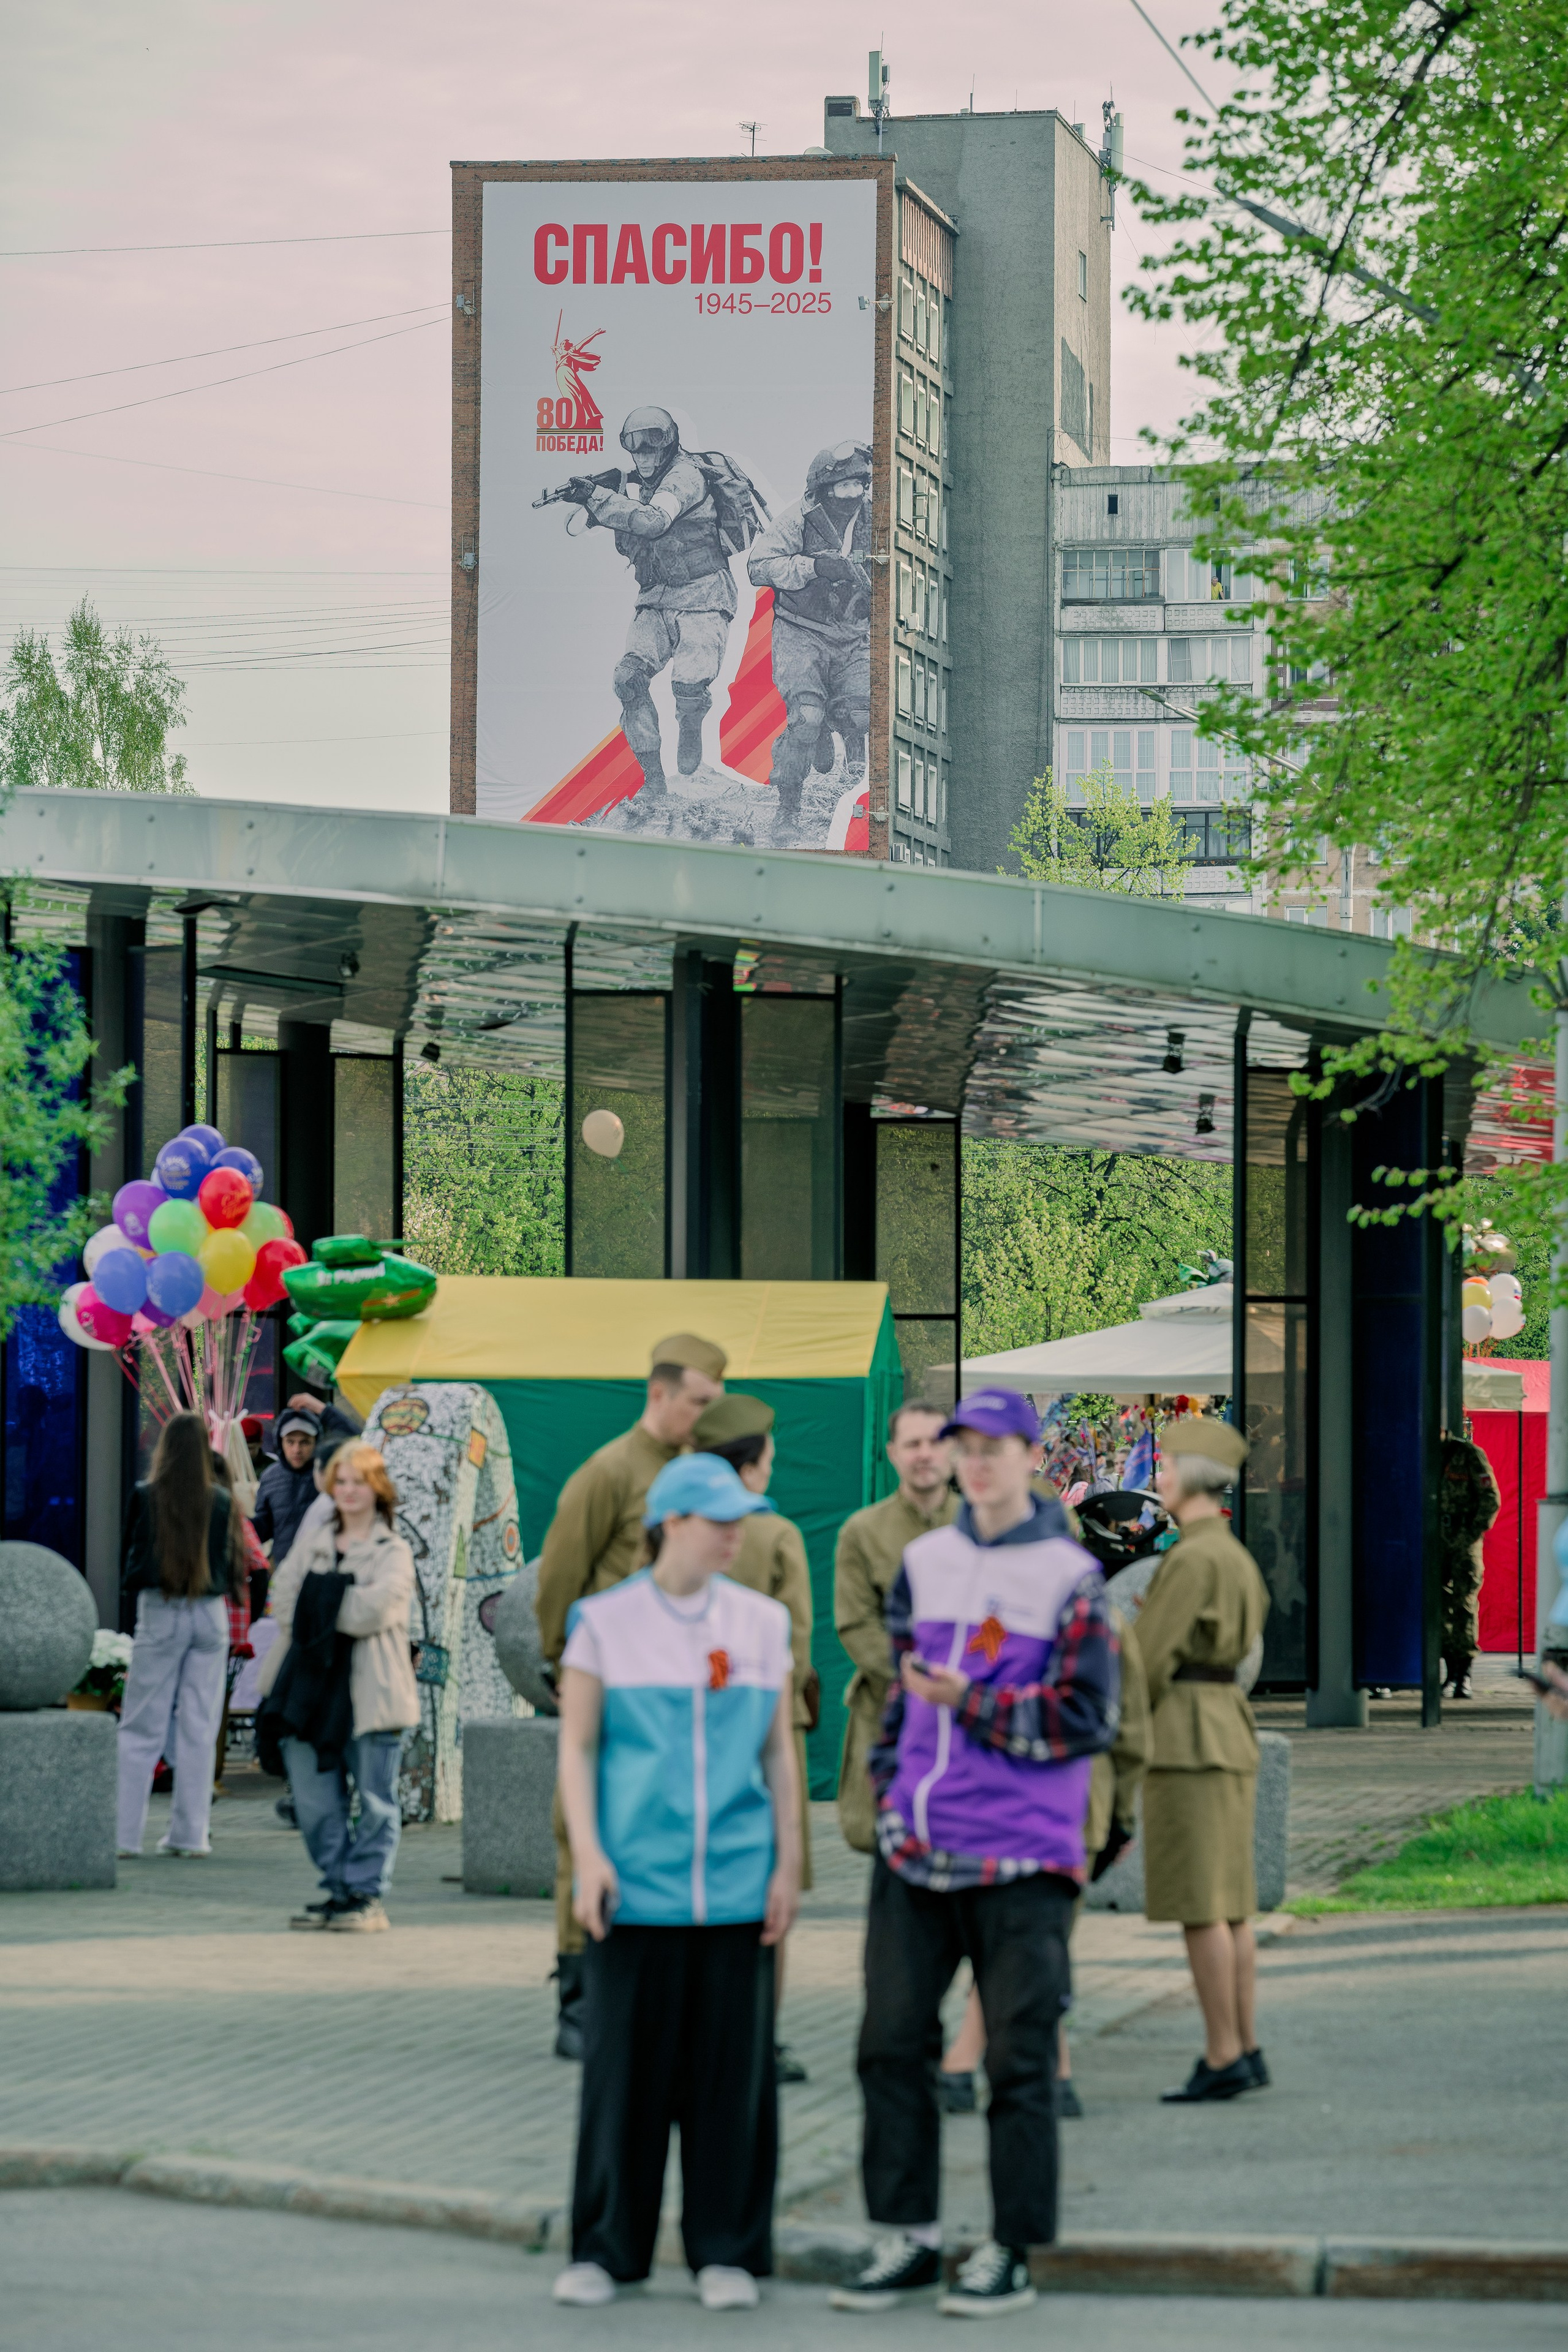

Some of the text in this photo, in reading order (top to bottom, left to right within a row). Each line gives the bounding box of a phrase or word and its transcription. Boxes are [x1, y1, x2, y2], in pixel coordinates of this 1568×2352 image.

[534, 222, 823, 285] СПАСИБО!
[537, 397, 573, 429] 80
[537, 435, 603, 454] ПОБЕДА!
